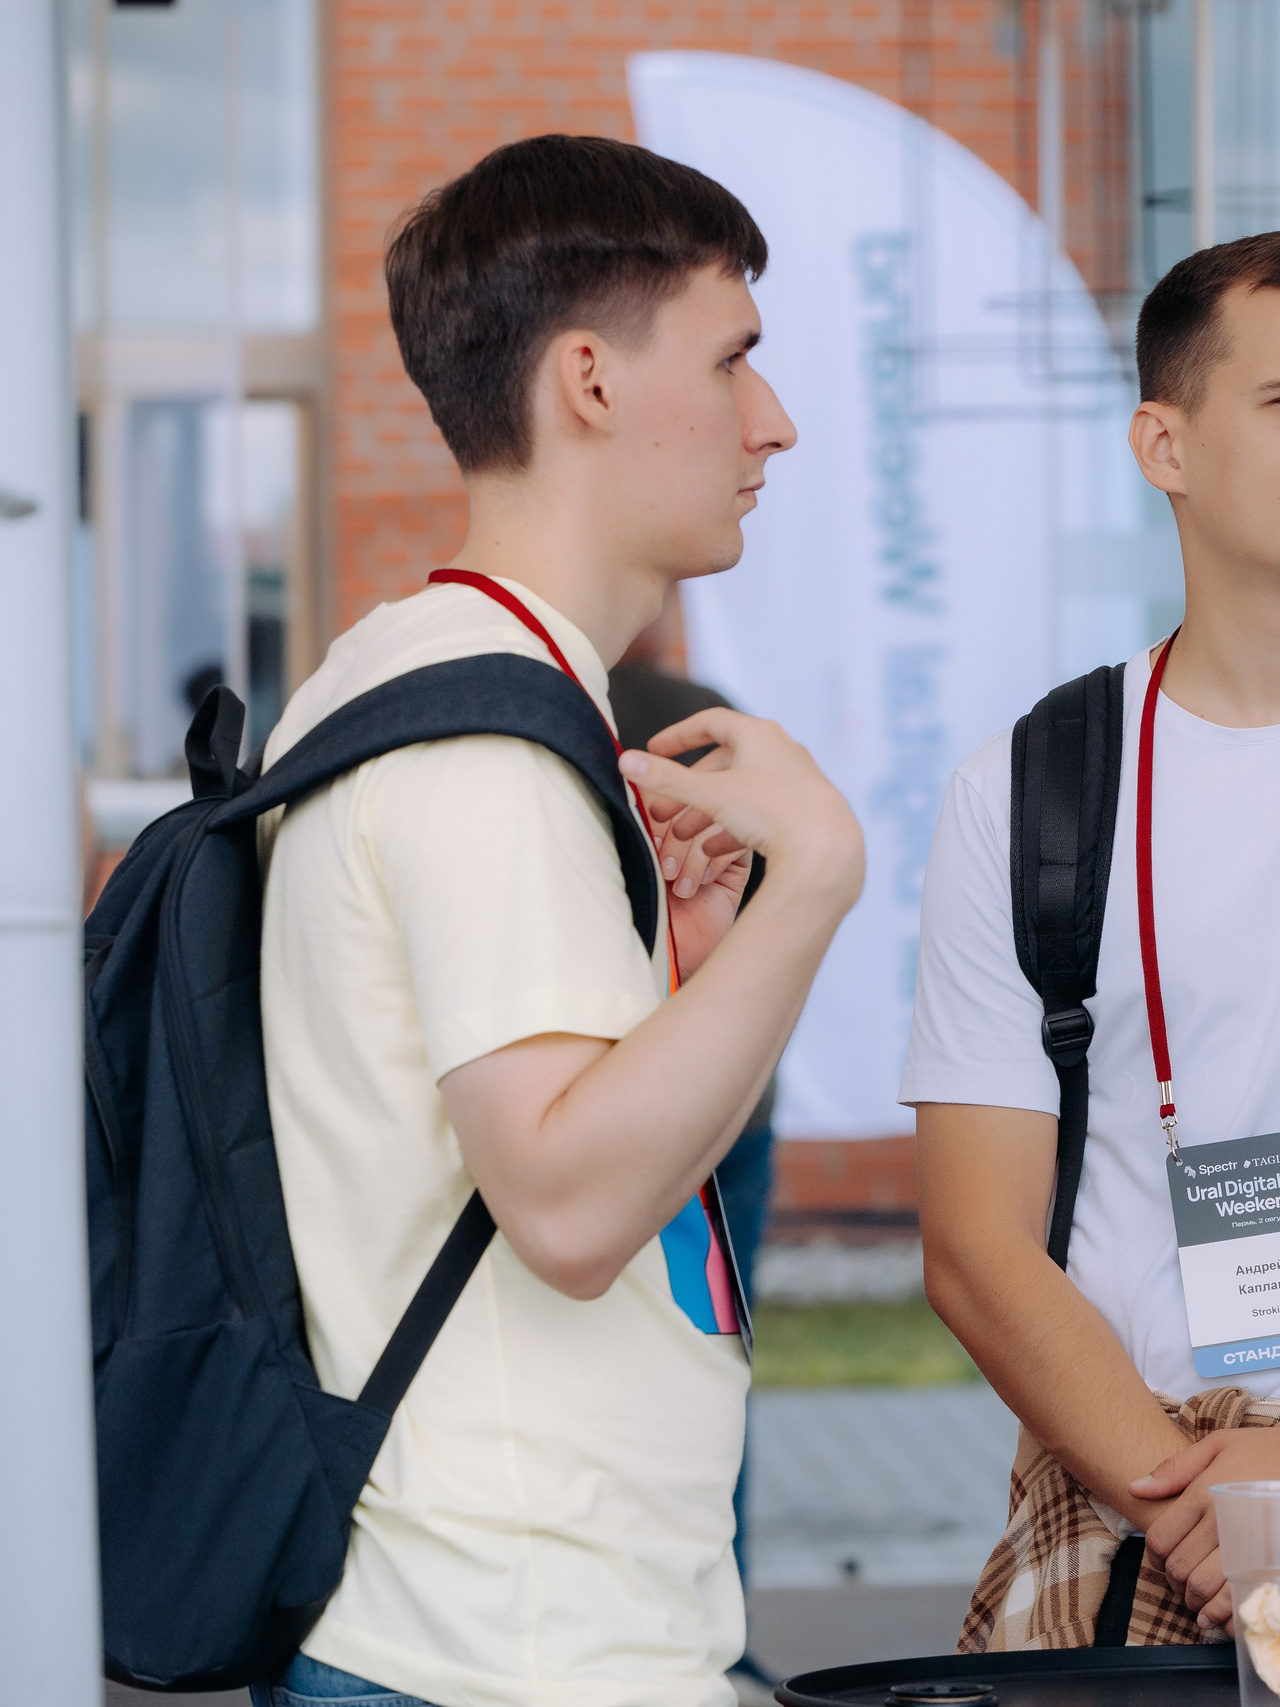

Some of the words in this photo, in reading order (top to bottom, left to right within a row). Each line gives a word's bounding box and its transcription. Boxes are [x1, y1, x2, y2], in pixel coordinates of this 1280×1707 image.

[1198, 1160, 1238, 1176] Spectr
[1187, 1182, 1222, 1202] Ural
[1231, 1219, 1257, 1228] Пермь,
[1252, 1305, 1280, 1317] Stroki
